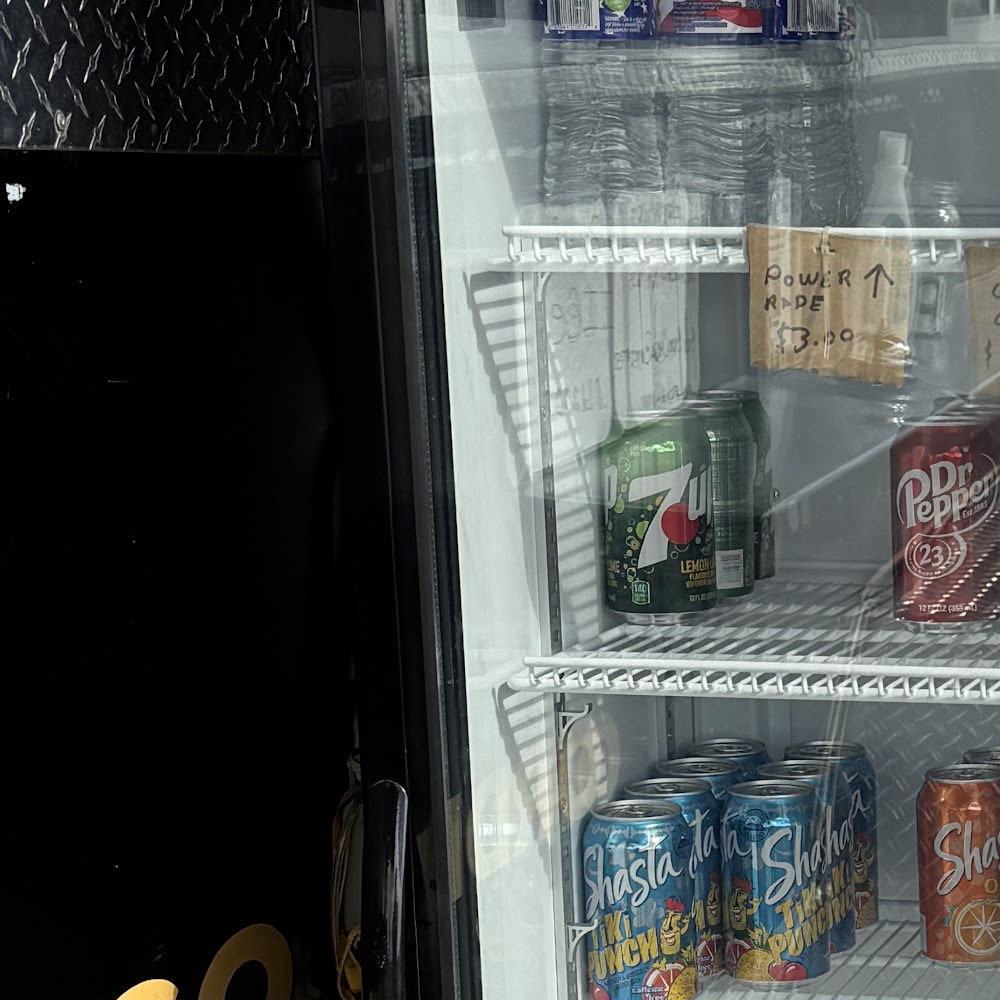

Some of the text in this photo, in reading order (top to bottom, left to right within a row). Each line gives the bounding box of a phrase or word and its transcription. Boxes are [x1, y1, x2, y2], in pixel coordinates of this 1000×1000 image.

[897, 469, 996, 530] Pepper
[930, 461, 974, 497] Dr
[919, 543, 944, 567] 23
[583, 833, 684, 920] Shasta
